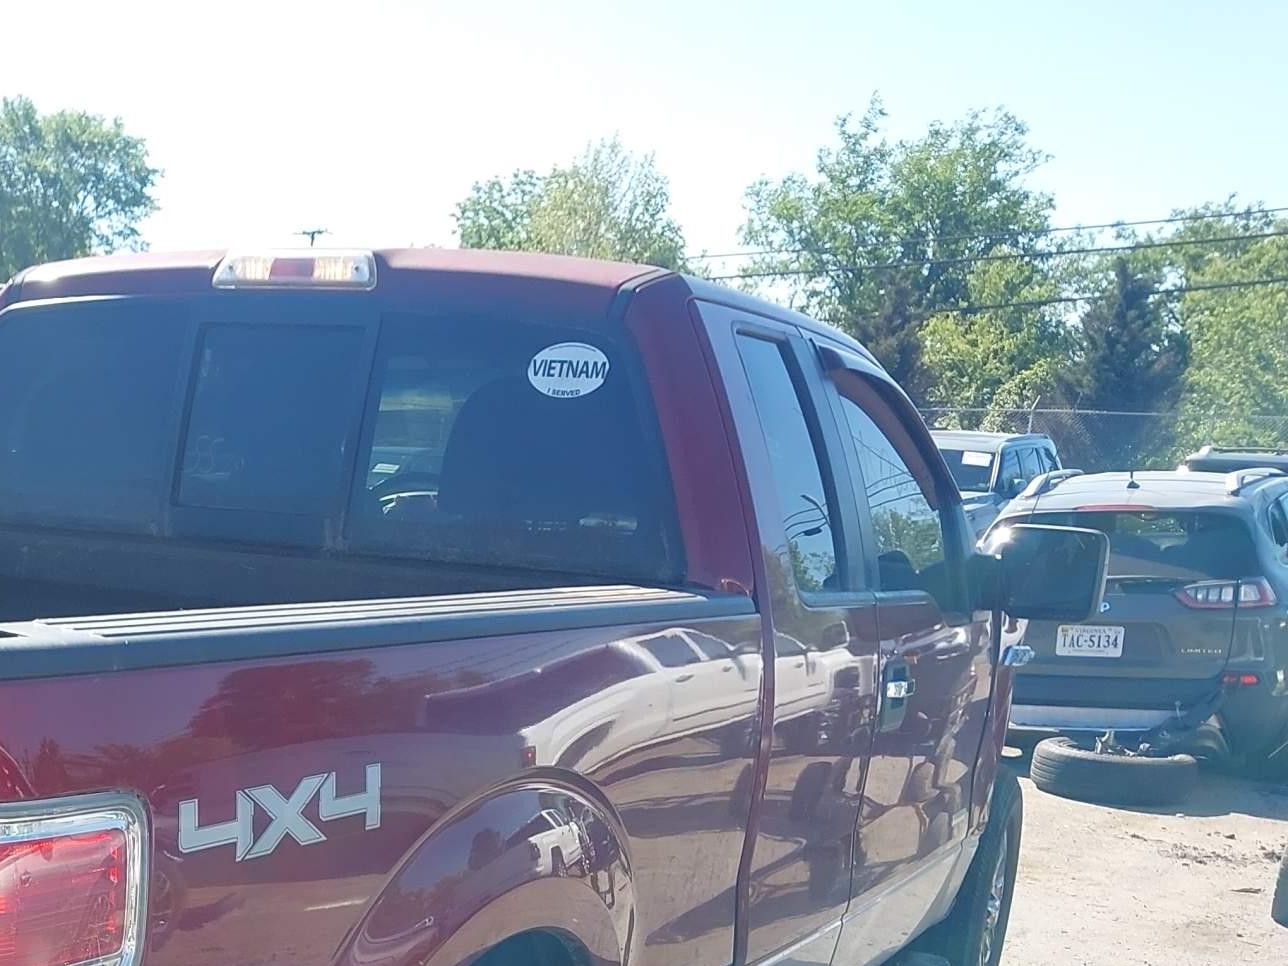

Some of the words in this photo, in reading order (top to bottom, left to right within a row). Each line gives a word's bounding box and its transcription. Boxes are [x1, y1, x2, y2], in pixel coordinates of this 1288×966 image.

[533, 359, 607, 379] VIETNAM
[552, 388, 581, 397] SERVED
[1062, 634, 1119, 649] TAC-5134
[178, 762, 381, 862] 4X4
